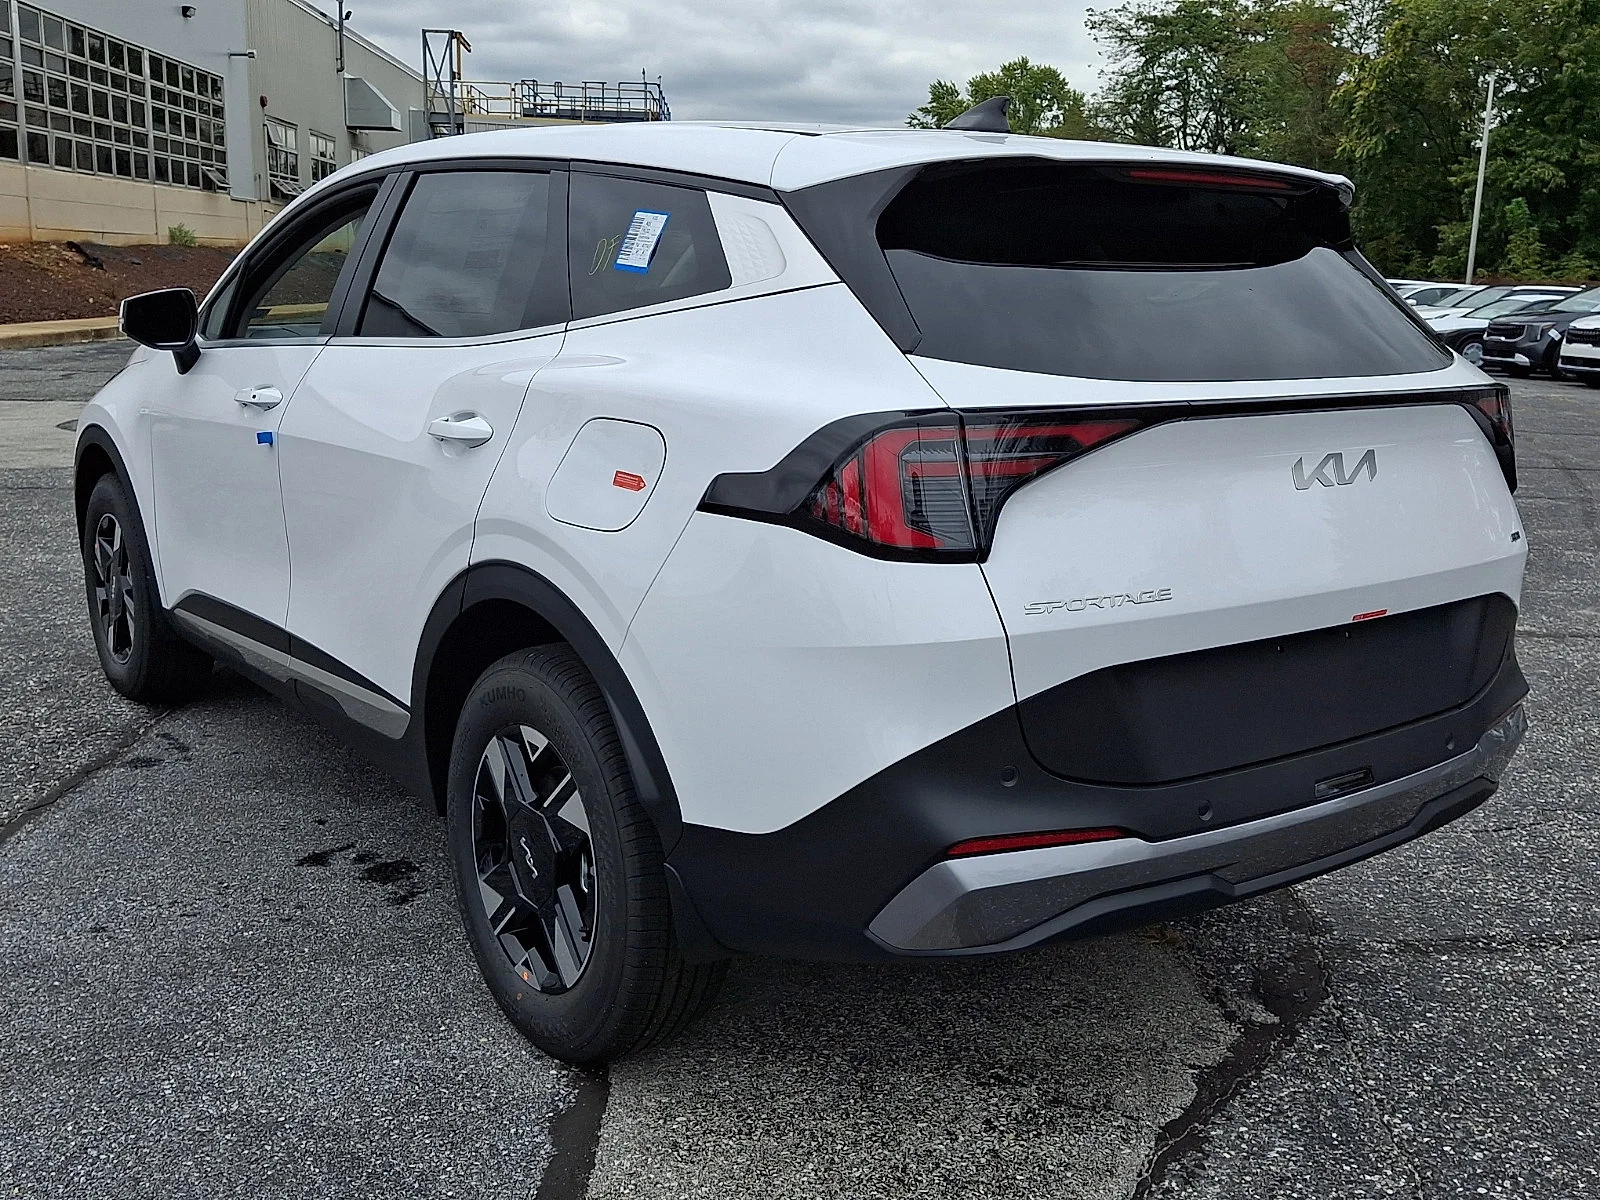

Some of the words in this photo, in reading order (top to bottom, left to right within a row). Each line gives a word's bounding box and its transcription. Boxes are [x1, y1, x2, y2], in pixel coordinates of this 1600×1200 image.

[1291, 449, 1377, 490] KIA
[1024, 587, 1173, 616] SPORTAGE
[479, 686, 526, 708] KUMHO
